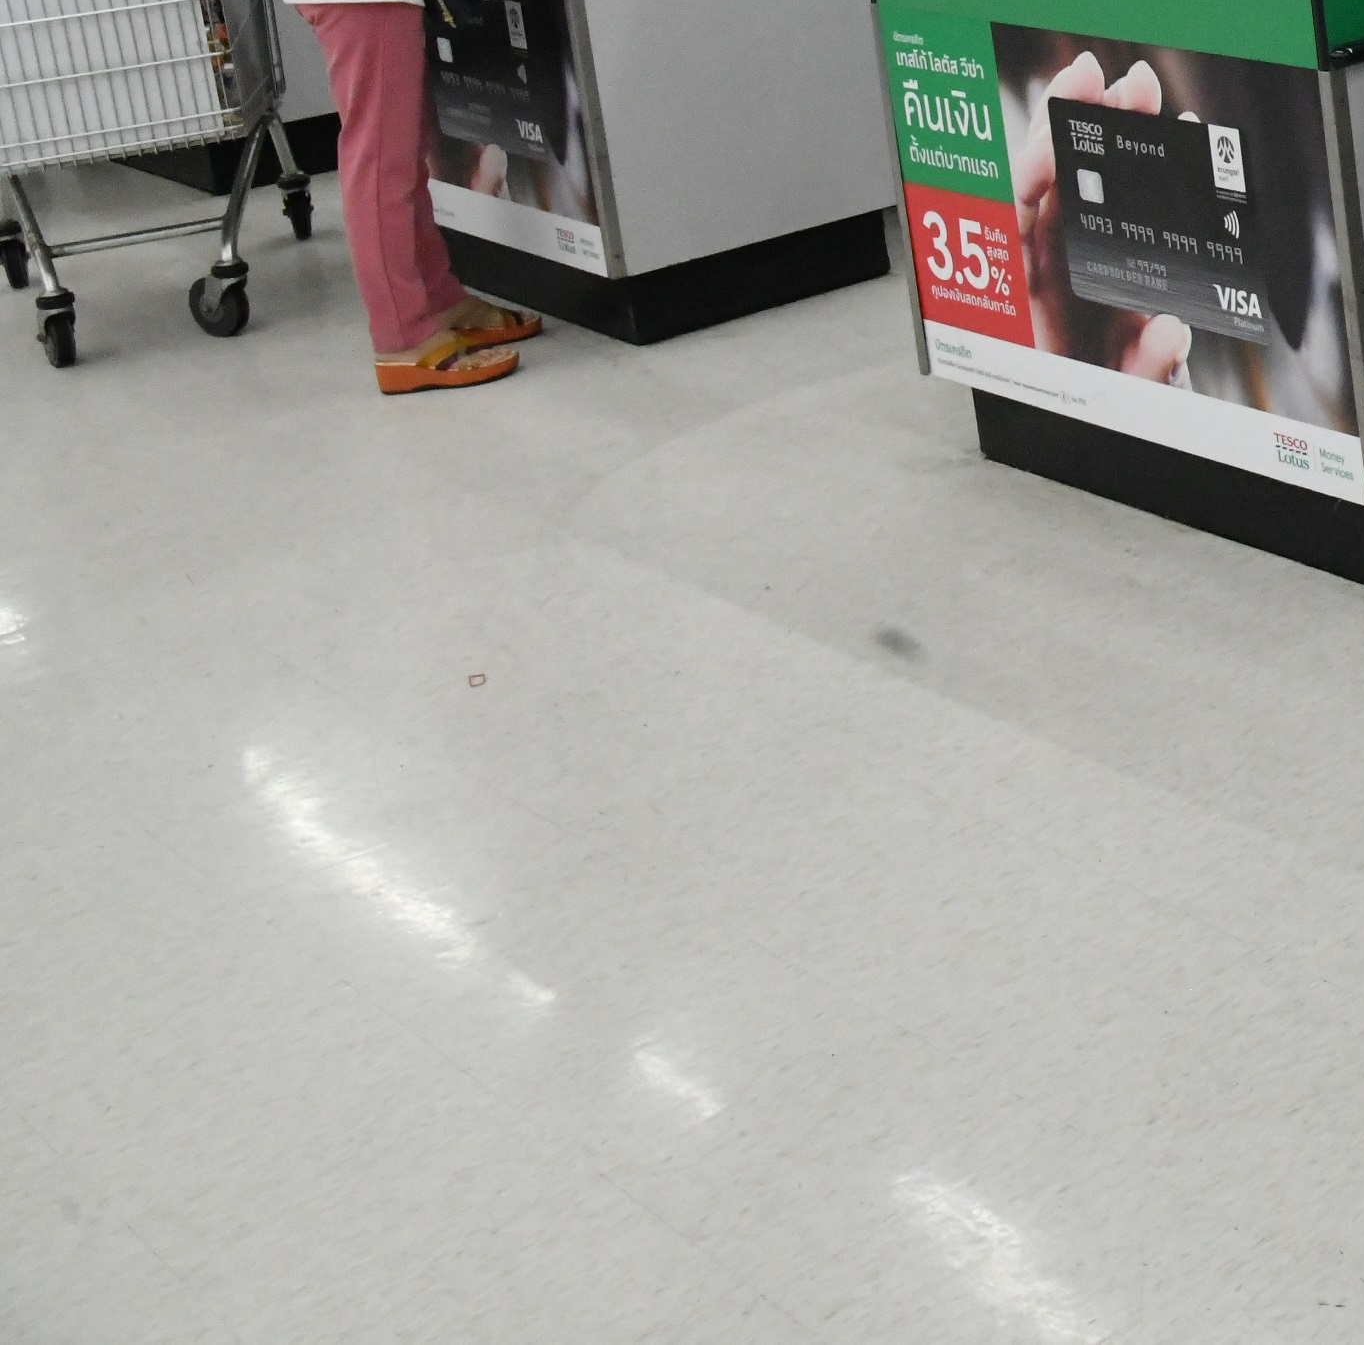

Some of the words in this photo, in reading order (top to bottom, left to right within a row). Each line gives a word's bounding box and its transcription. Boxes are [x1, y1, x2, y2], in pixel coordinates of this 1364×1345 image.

[896, 48, 928, 69] เทสโก้
[929, 52, 959, 75] โลตัส
[962, 57, 985, 80] วีซ่า
[902, 79, 992, 141] คืนเงิน
[515, 118, 544, 144] VISA
[1069, 119, 1103, 137] TESCO
[909, 135, 999, 179] ตั้งแต่บาทแรก
[1073, 137, 1105, 155] Lotus
[1116, 135, 1165, 157] Beyond
[984, 225, 1008, 245] รับคืน
[1080, 213, 1113, 235] 4093
[1121, 221, 1155, 244] 9999
[1163, 231, 1198, 254] 9999
[1207, 241, 1243, 264] 9999
[923, 210, 990, 290] 3.5
[986, 246, 1009, 264] สูงสุด
[931, 283, 1017, 316] คูปองเงินสดคลับการ์ด
[1213, 284, 1262, 319] VISA
[1274, 432, 1308, 451] TESCO
[1277, 449, 1310, 470] Lotus
[1319, 447, 1346, 465] Money
[1320, 460, 1355, 481] Services
